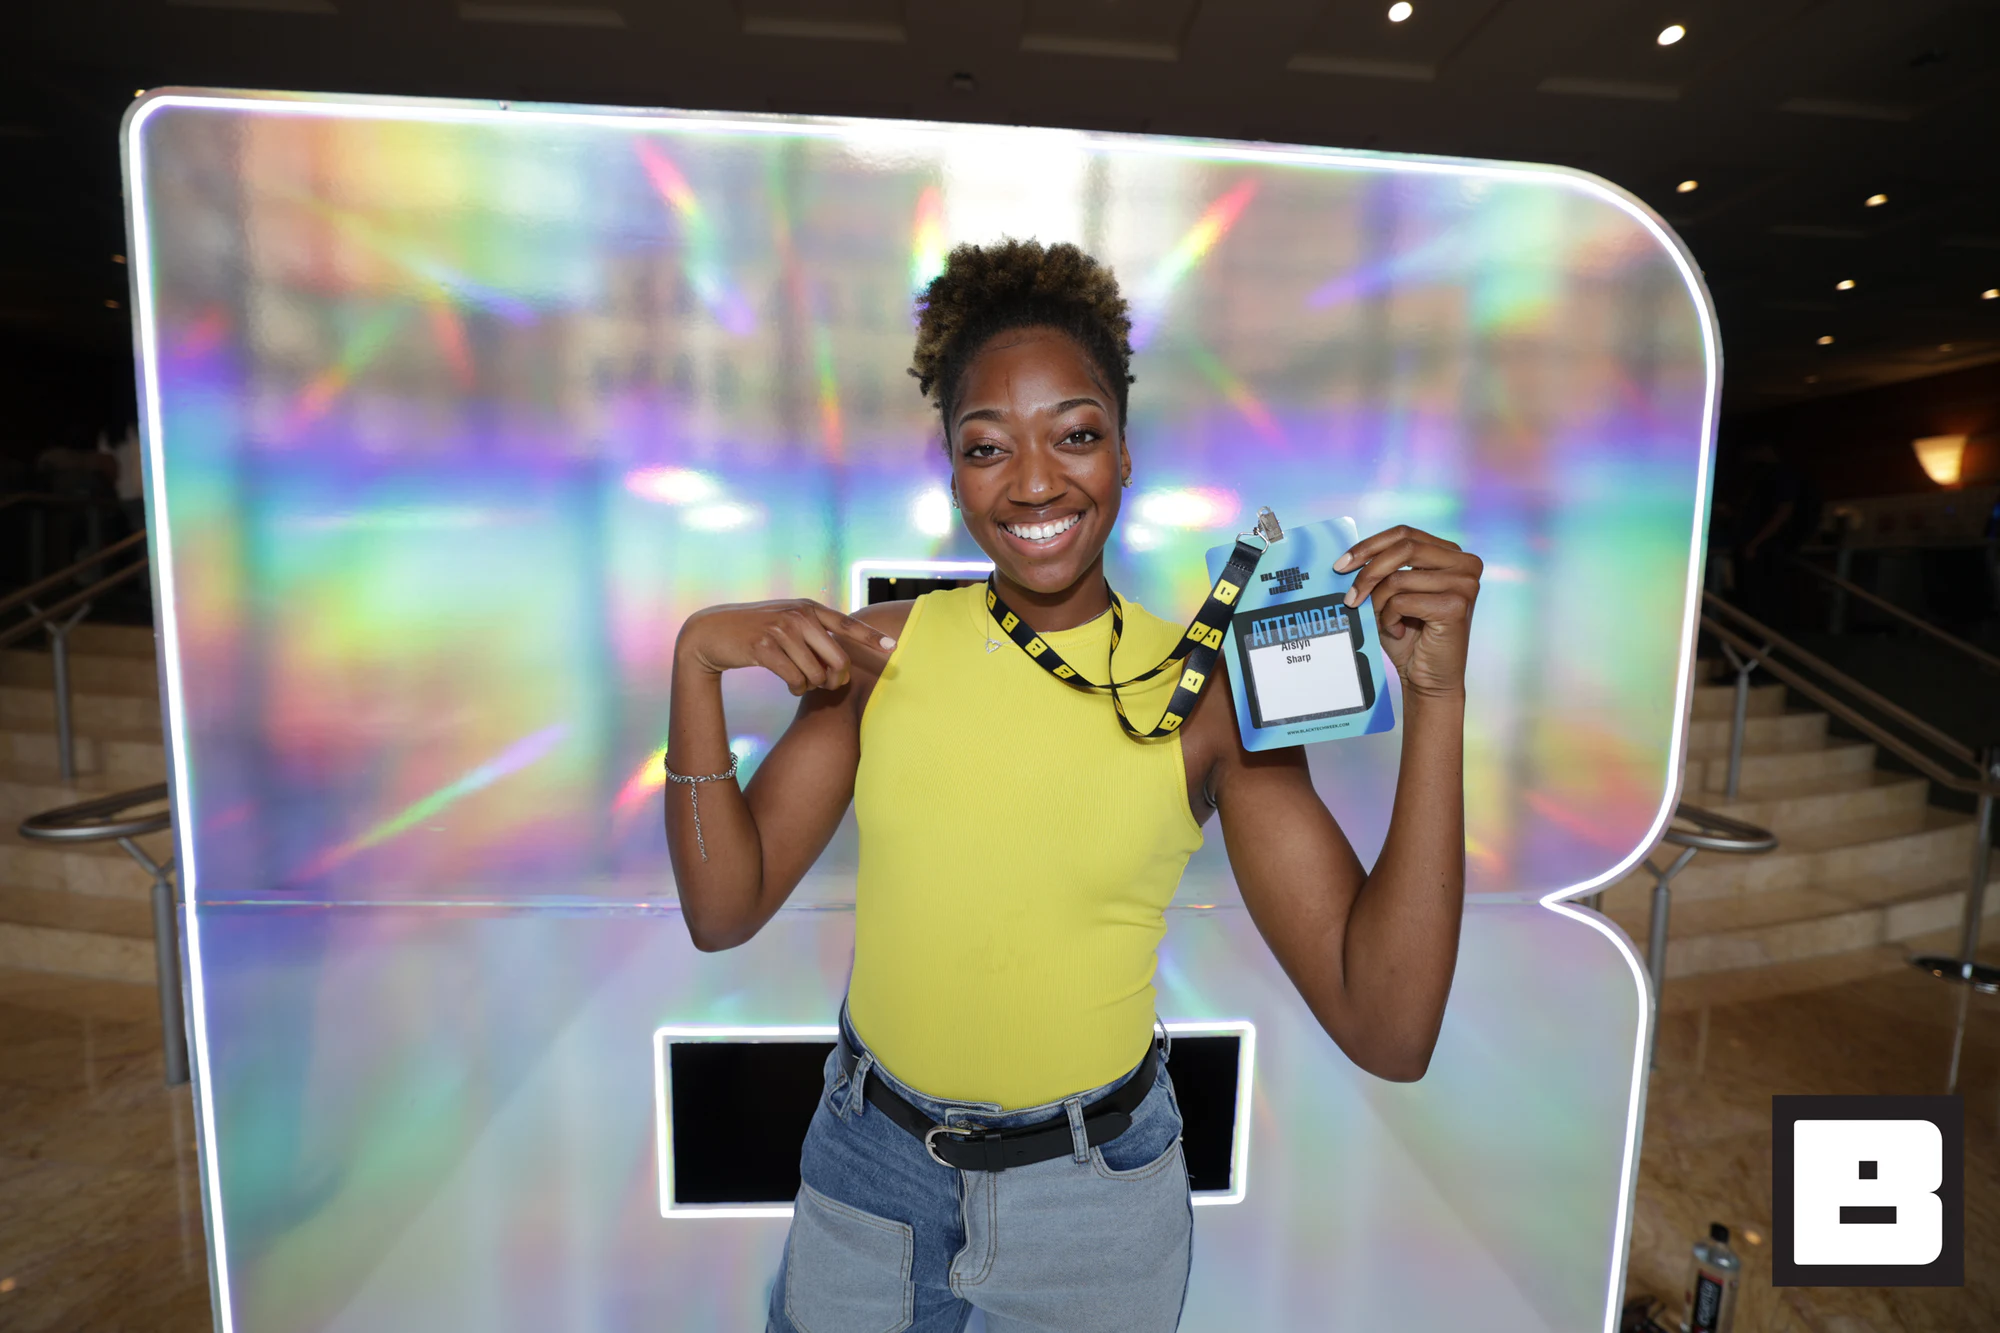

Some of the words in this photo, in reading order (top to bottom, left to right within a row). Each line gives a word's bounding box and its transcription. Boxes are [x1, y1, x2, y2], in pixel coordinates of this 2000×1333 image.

[1260, 567, 1300, 582] BLACK
[1277, 573, 1310, 586] TECH
[1269, 582, 1303, 595] WEEK
[1252, 604, 1350, 647] ATTENDEE
[1286, 654, 1311, 664] Sharp
[1287, 722, 1350, 735] WWW.BLACKTECHWEEK.COM
